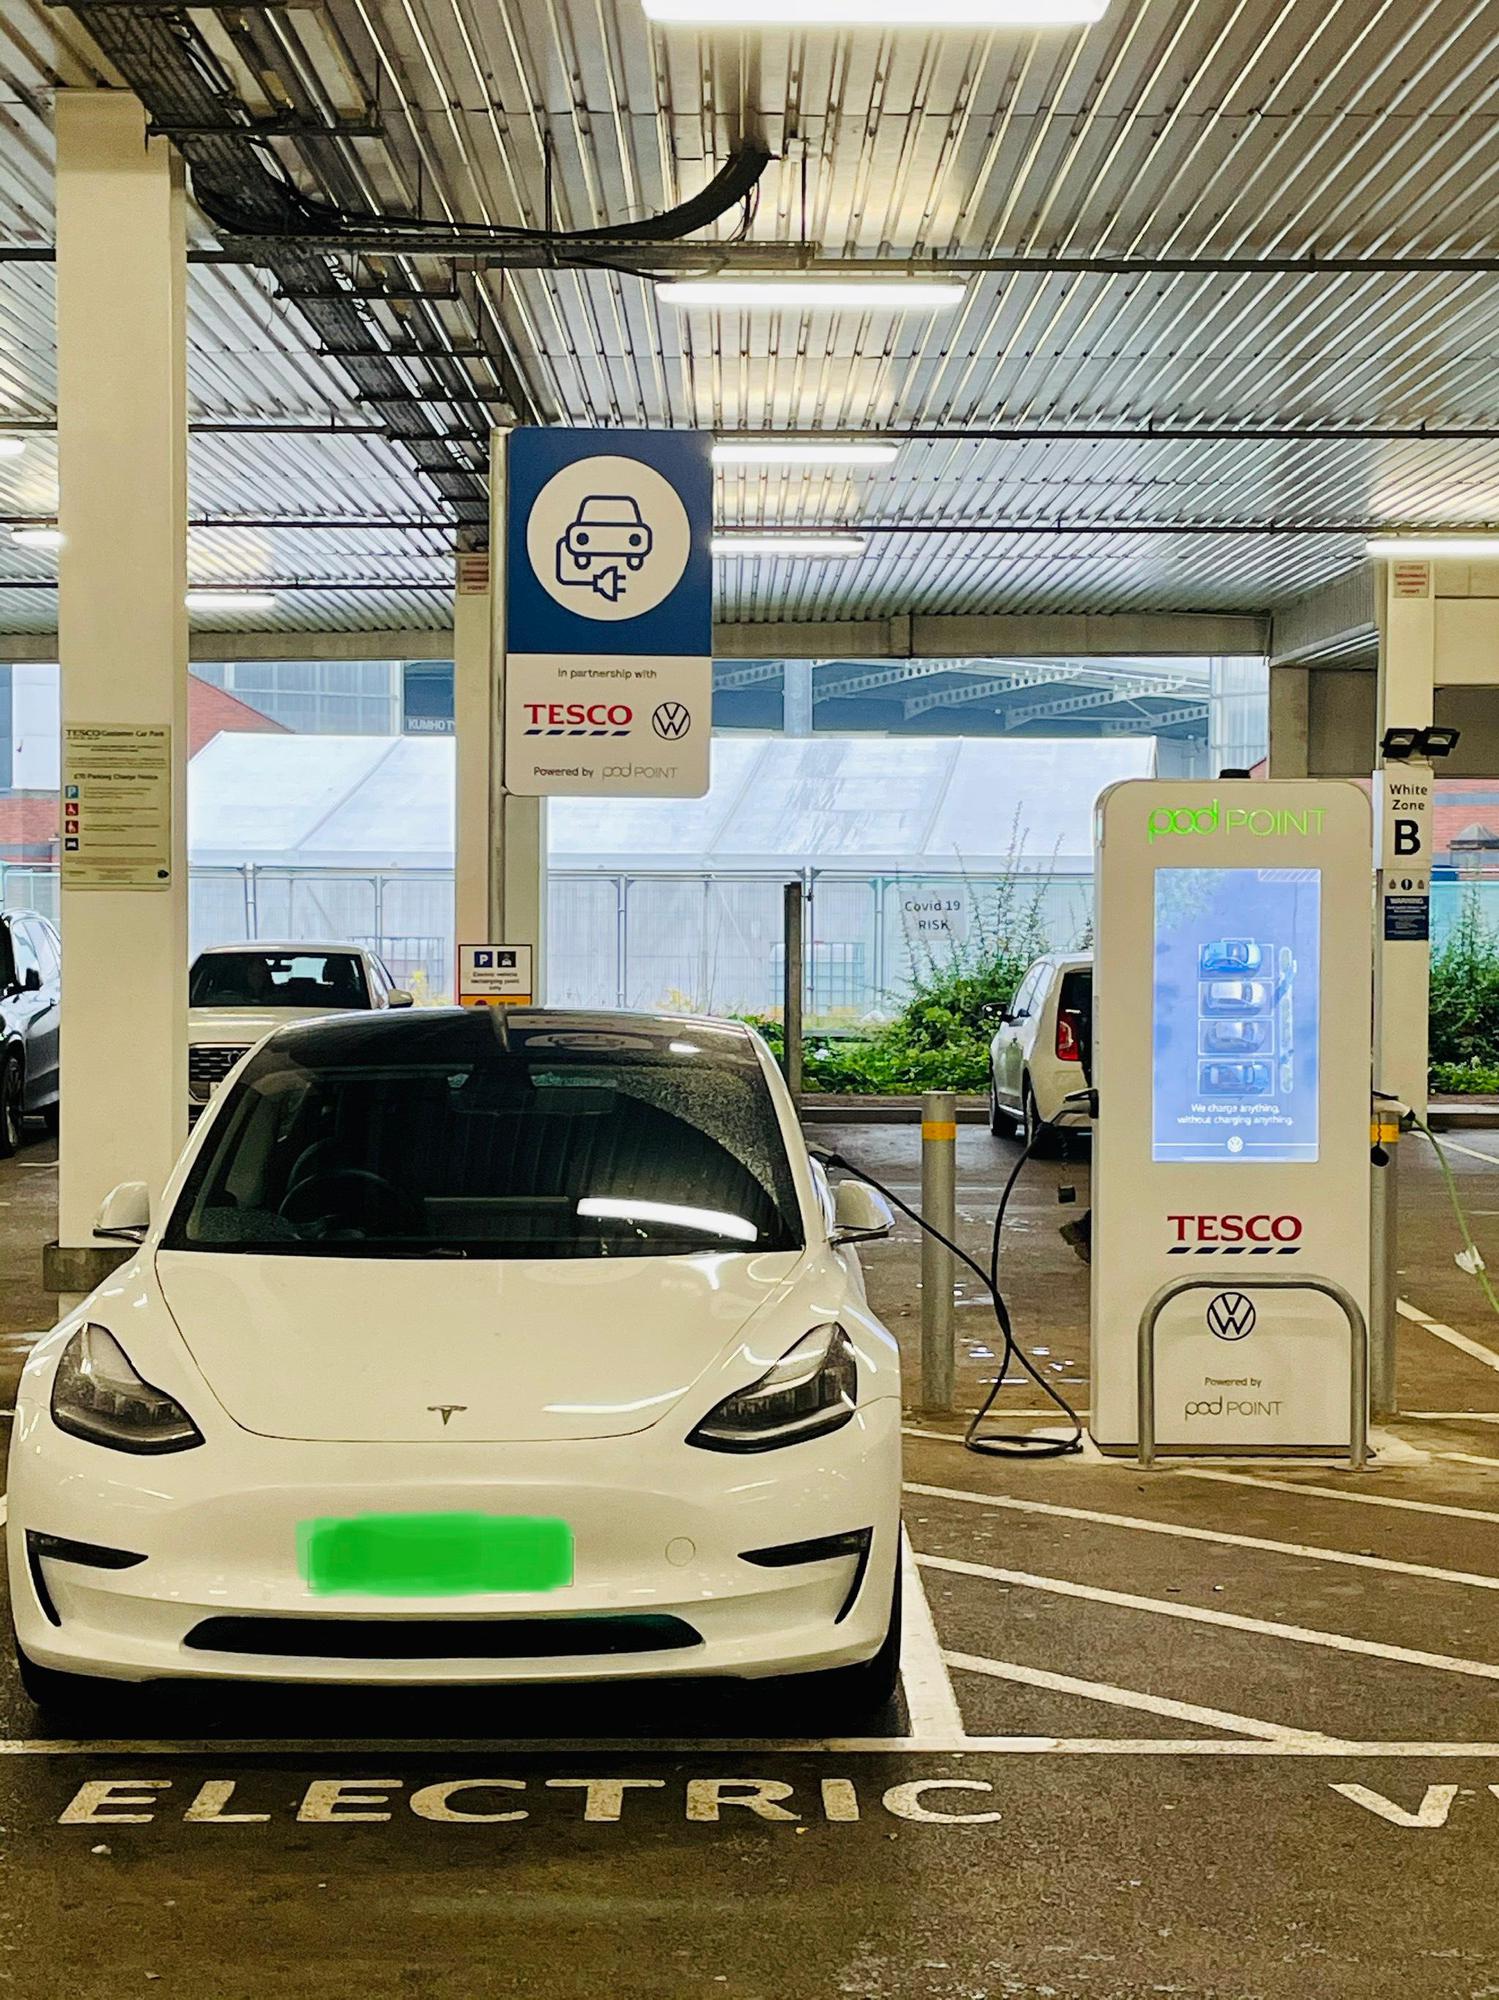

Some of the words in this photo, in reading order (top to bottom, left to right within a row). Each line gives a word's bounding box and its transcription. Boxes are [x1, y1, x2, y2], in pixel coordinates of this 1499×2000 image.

[558, 668, 568, 677] In
[570, 669, 632, 680] partnership
[635, 669, 657, 679] with
[523, 703, 633, 725] TESCO
[408, 718, 446, 730] KUMHO
[66, 729, 100, 737] TESCO
[88, 773, 112, 781] Parking
[534, 766, 579, 777] Powered
[582, 766, 594, 778] by
[602, 763, 632, 780] pod
[634, 767, 678, 778] POINT
[1389, 784, 1428, 796] White
[1392, 800, 1425, 811] Zone
[1148, 799, 1220, 844] pod
[1226, 808, 1327, 836] POINT
[1394, 819, 1421, 855] B
[905, 900, 941, 911] Covid
[946, 900, 960, 911] 19
[919, 920, 949, 930] RISK
[1191, 1104, 1206, 1113] We
[1208, 1103, 1238, 1114] charge
[1177, 1115, 1211, 1124] without
[1214, 1116, 1251, 1126] charging
[1167, 1215, 1303, 1242] TESCO
[1205, 1377, 1248, 1386] Powered
[1250, 1377, 1262, 1388] by
[1185, 1396, 1222, 1421] pod
[1227, 1401, 1283, 1416] POINT
[58, 1779, 1001, 1825] ELECTRIC
